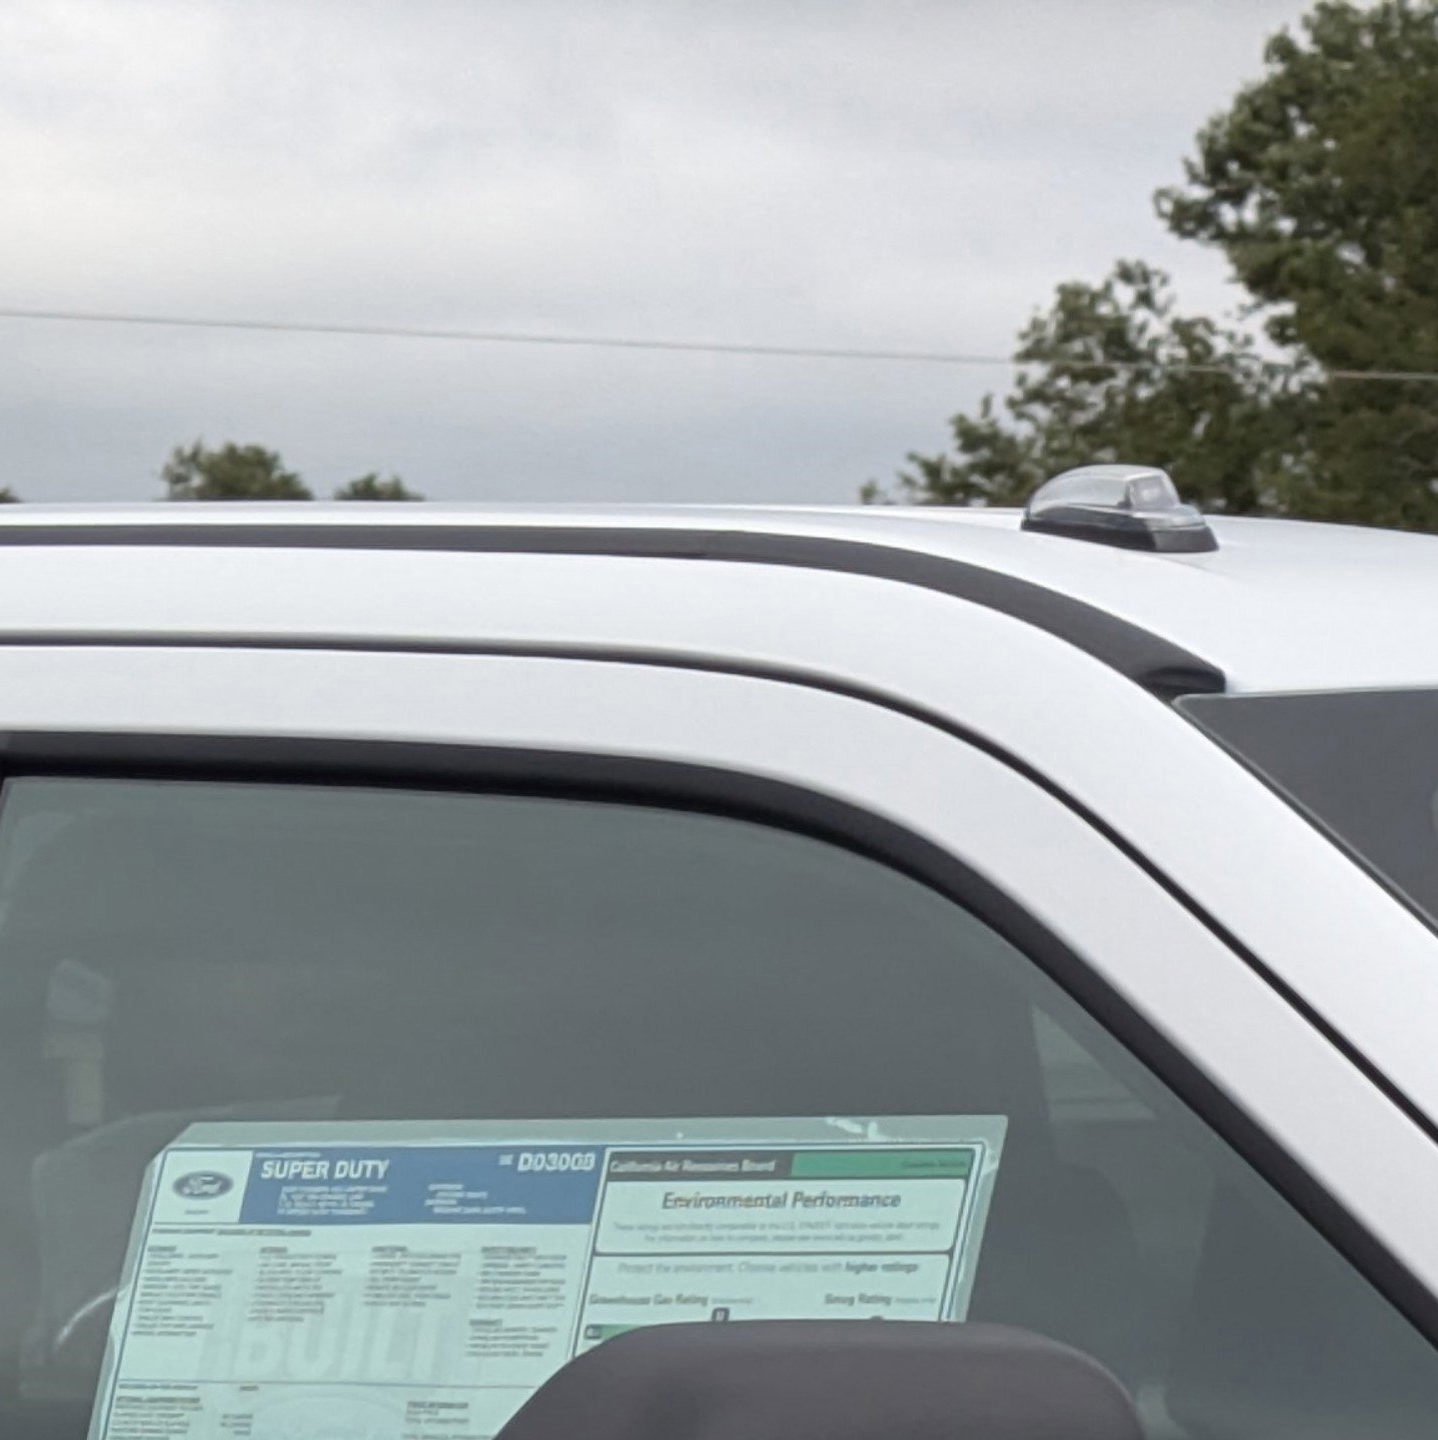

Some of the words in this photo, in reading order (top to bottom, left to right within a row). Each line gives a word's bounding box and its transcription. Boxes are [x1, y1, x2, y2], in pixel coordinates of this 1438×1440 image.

[261, 1160, 330, 1180] SUPER
[334, 1160, 390, 1180] DUTY
[662, 1190, 788, 1210] Environmental
[791, 1190, 902, 1210] Performance
